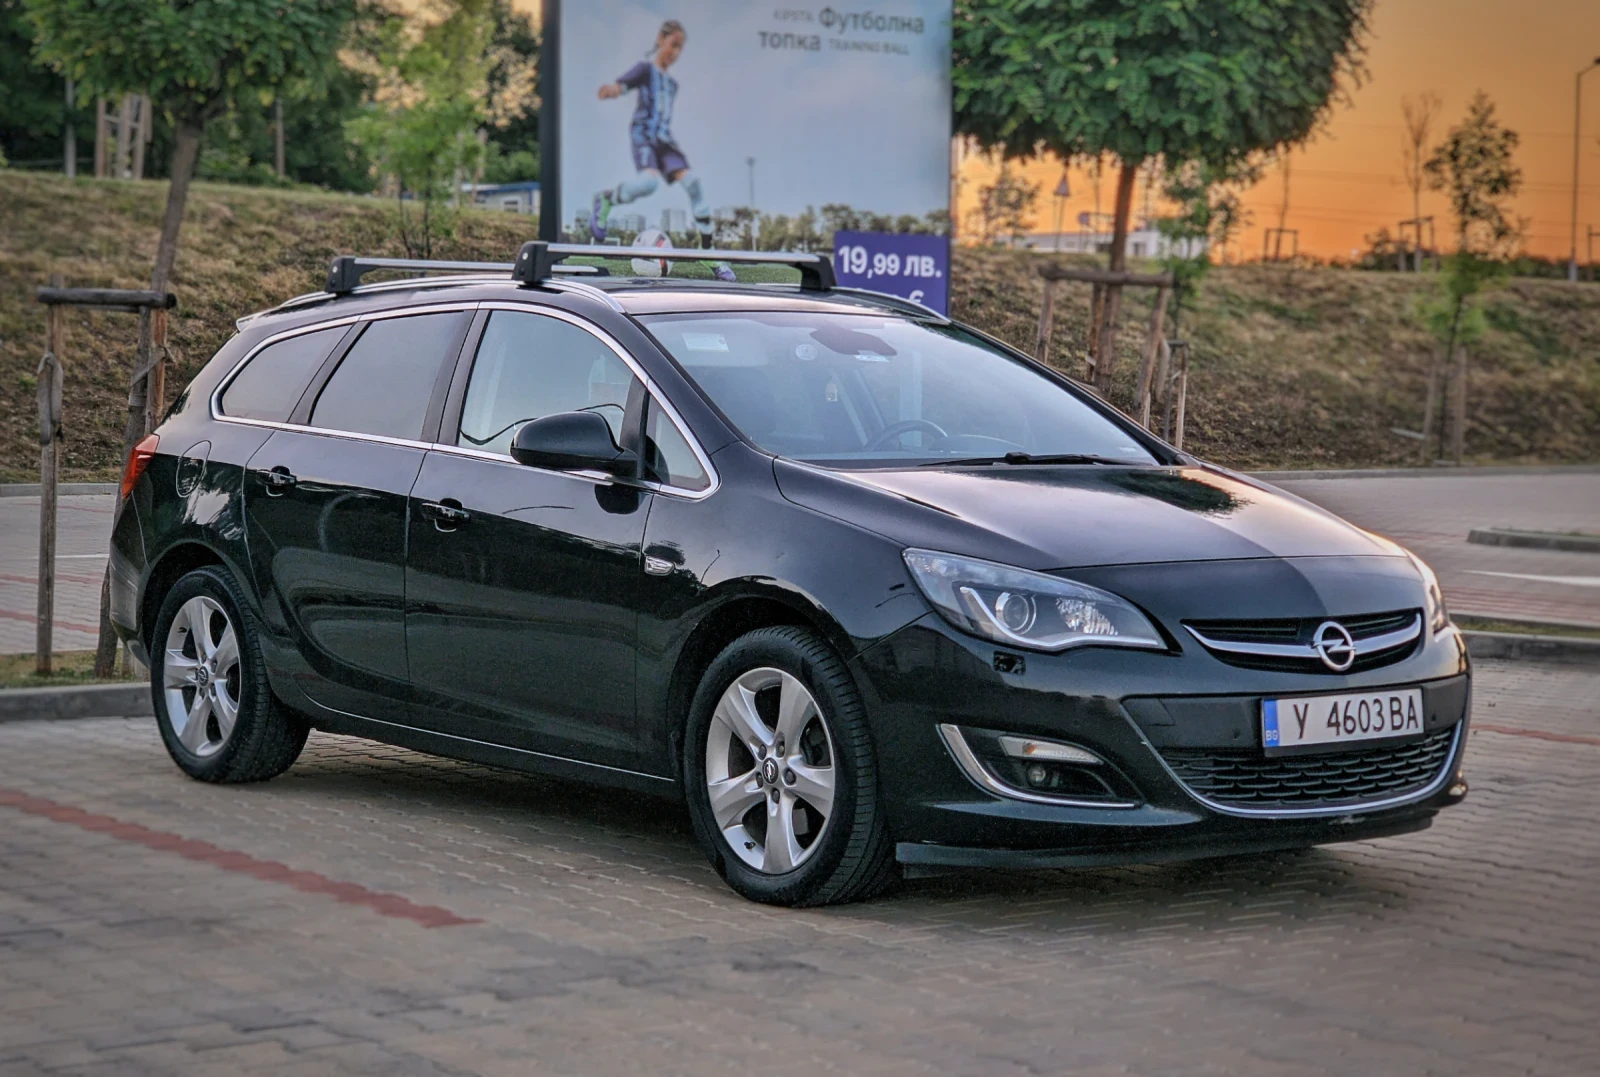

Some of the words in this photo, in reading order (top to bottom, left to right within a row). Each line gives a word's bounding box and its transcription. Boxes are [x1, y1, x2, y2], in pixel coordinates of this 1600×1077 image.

[819, 6, 925, 34] Футболна
[758, 31, 821, 51] топка
[838, 245, 901, 279] 19,99
[1265, 730, 1279, 741] BG
